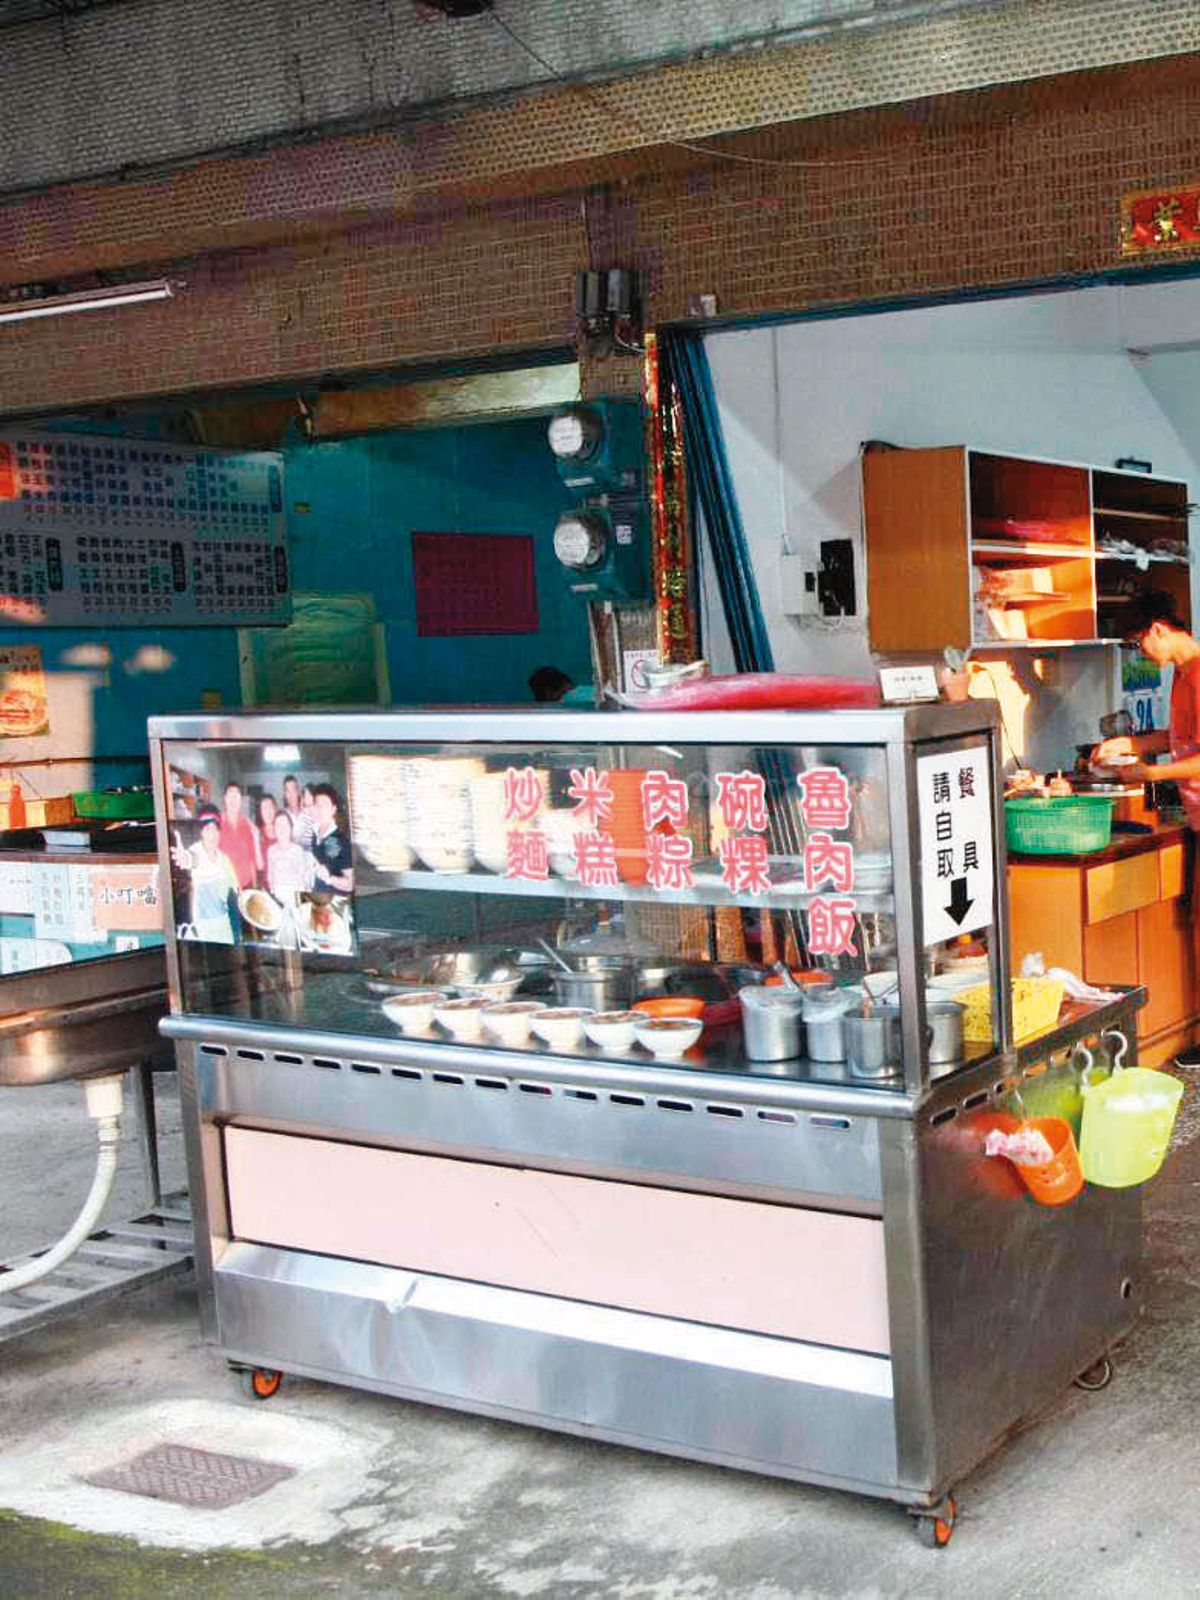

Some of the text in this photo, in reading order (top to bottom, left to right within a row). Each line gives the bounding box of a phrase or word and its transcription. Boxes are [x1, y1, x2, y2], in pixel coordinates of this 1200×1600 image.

[503, 766, 550, 883] 炒麵
[568, 767, 618, 889] 米糕
[641, 770, 696, 891] 肉粽
[715, 768, 773, 896] 碗粿
[797, 766, 859, 958] 魯肉飯
[933, 771, 955, 879] 請自取
[959, 766, 979, 874] 餐具
[100, 885, 157, 905] 小叮噹
